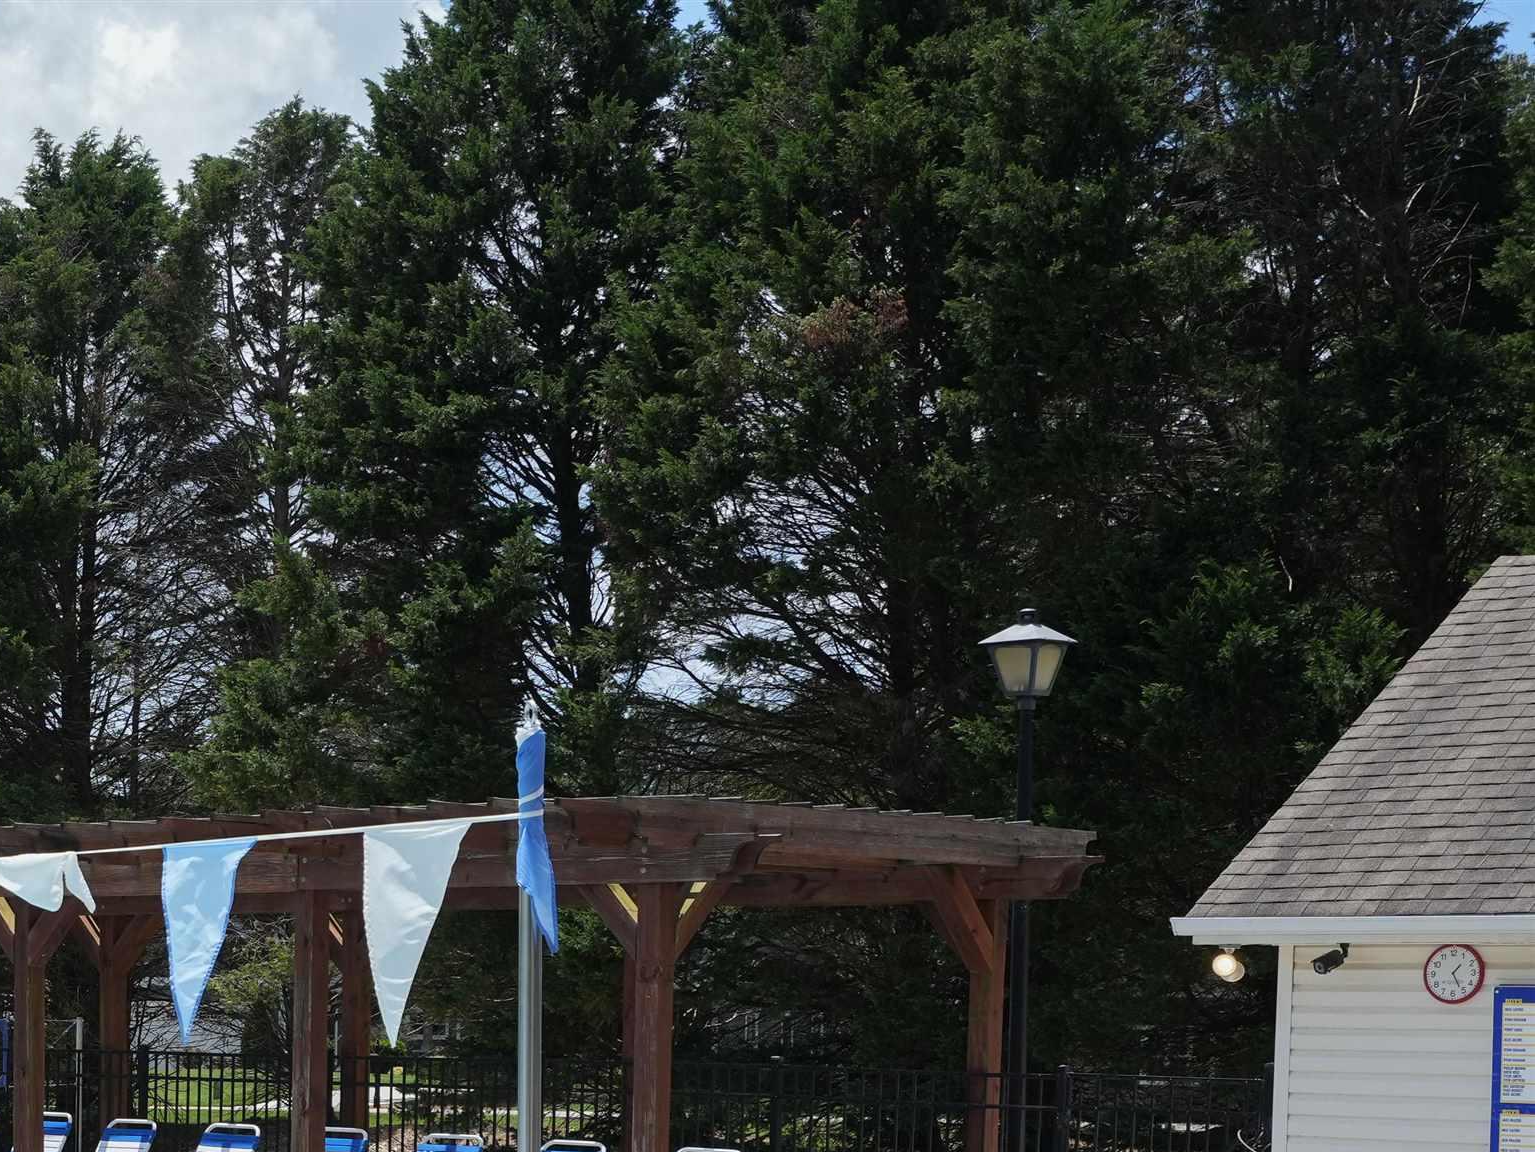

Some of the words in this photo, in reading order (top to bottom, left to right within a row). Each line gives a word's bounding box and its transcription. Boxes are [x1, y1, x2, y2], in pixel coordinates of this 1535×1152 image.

[1440, 953, 1447, 961] 11
[1450, 949, 1458, 957] 12
[1433, 960, 1442, 969] 10
[1468, 959, 1475, 967] 2
[1430, 970, 1436, 979] 9
[1470, 969, 1476, 977] 3
[1433, 980, 1440, 989] 8
[1441, 987, 1446, 995] 7
[1450, 990, 1456, 998] 6
[1461, 986, 1467, 994] 5
